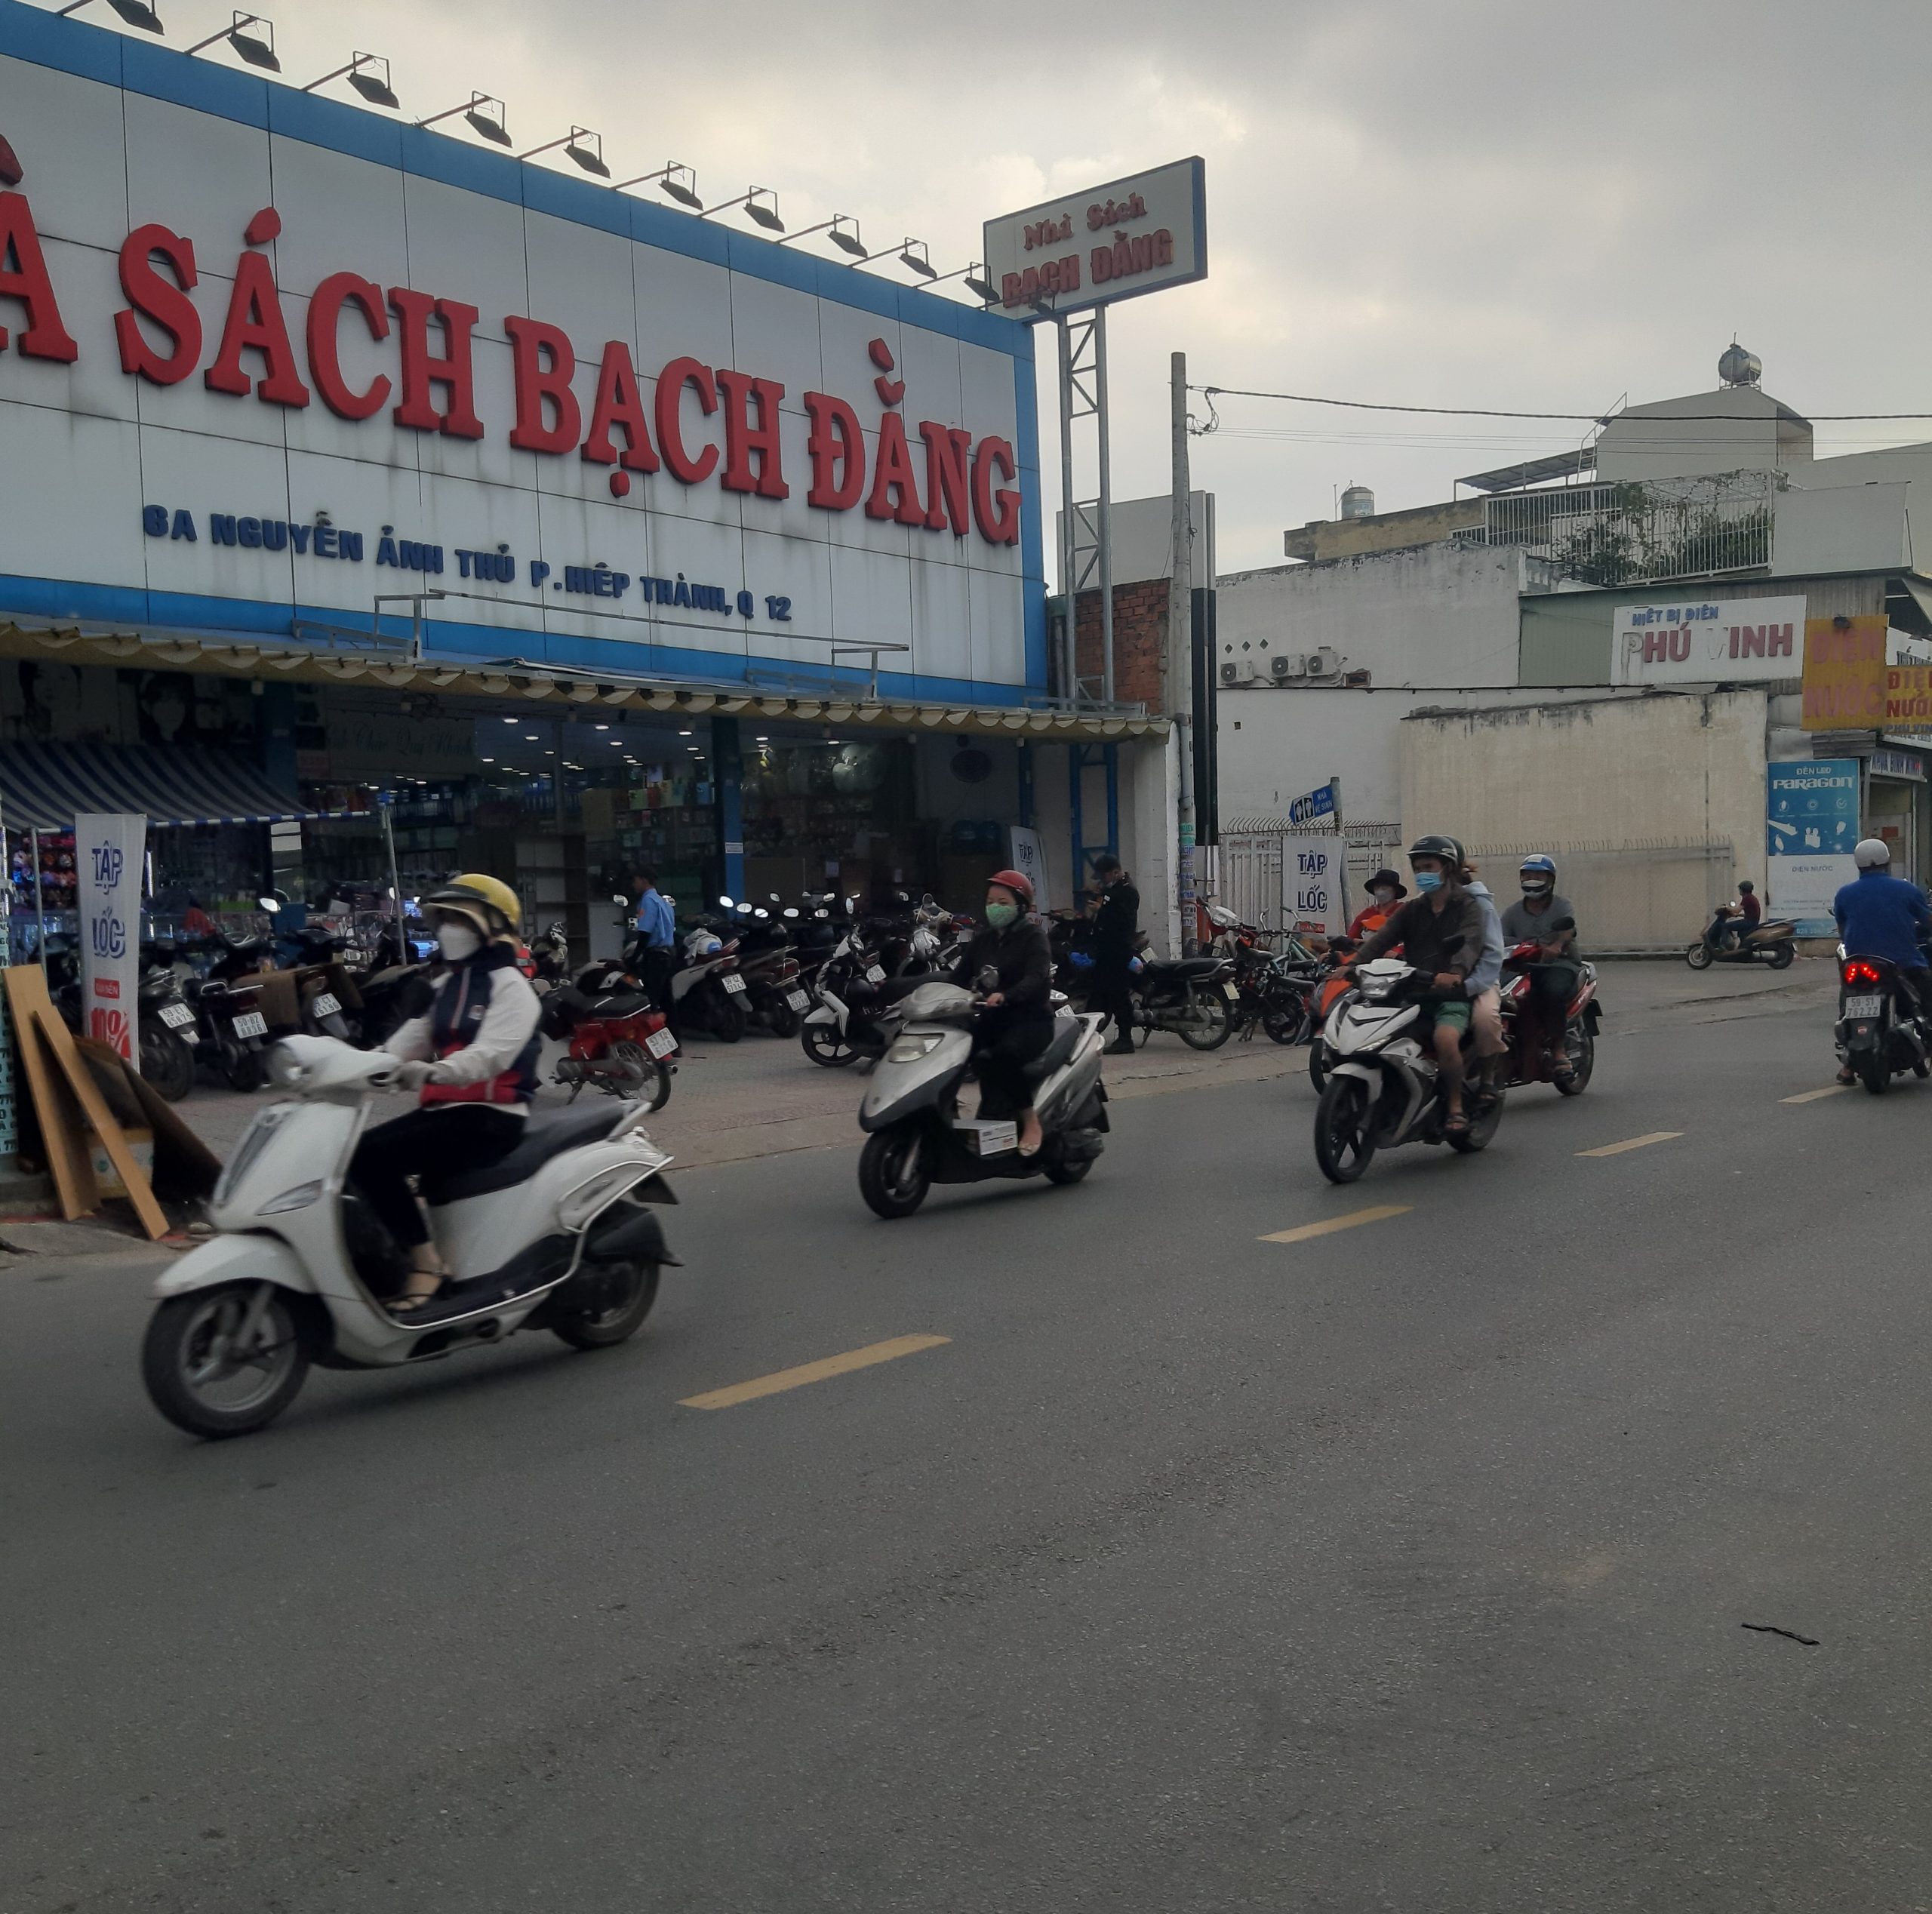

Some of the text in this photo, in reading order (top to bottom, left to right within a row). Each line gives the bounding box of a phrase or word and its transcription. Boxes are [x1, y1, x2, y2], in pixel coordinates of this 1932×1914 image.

[1023, 192, 1148, 251] Nhà Sách
[113, 206, 485, 440] SÁCH
[505, 315, 789, 500] BẠCH
[804, 337, 1021, 546] ĐẰNG
[376, 525, 444, 574] ẢNH
[454, 543, 515, 583] THỦ
[737, 590, 754, 620] Q
[764, 595, 792, 621] 12
[1887, 689, 1932, 718] NƯỚ
[1297, 850, 1328, 879] TẬP
[1297, 884, 1328, 913] LỐC
